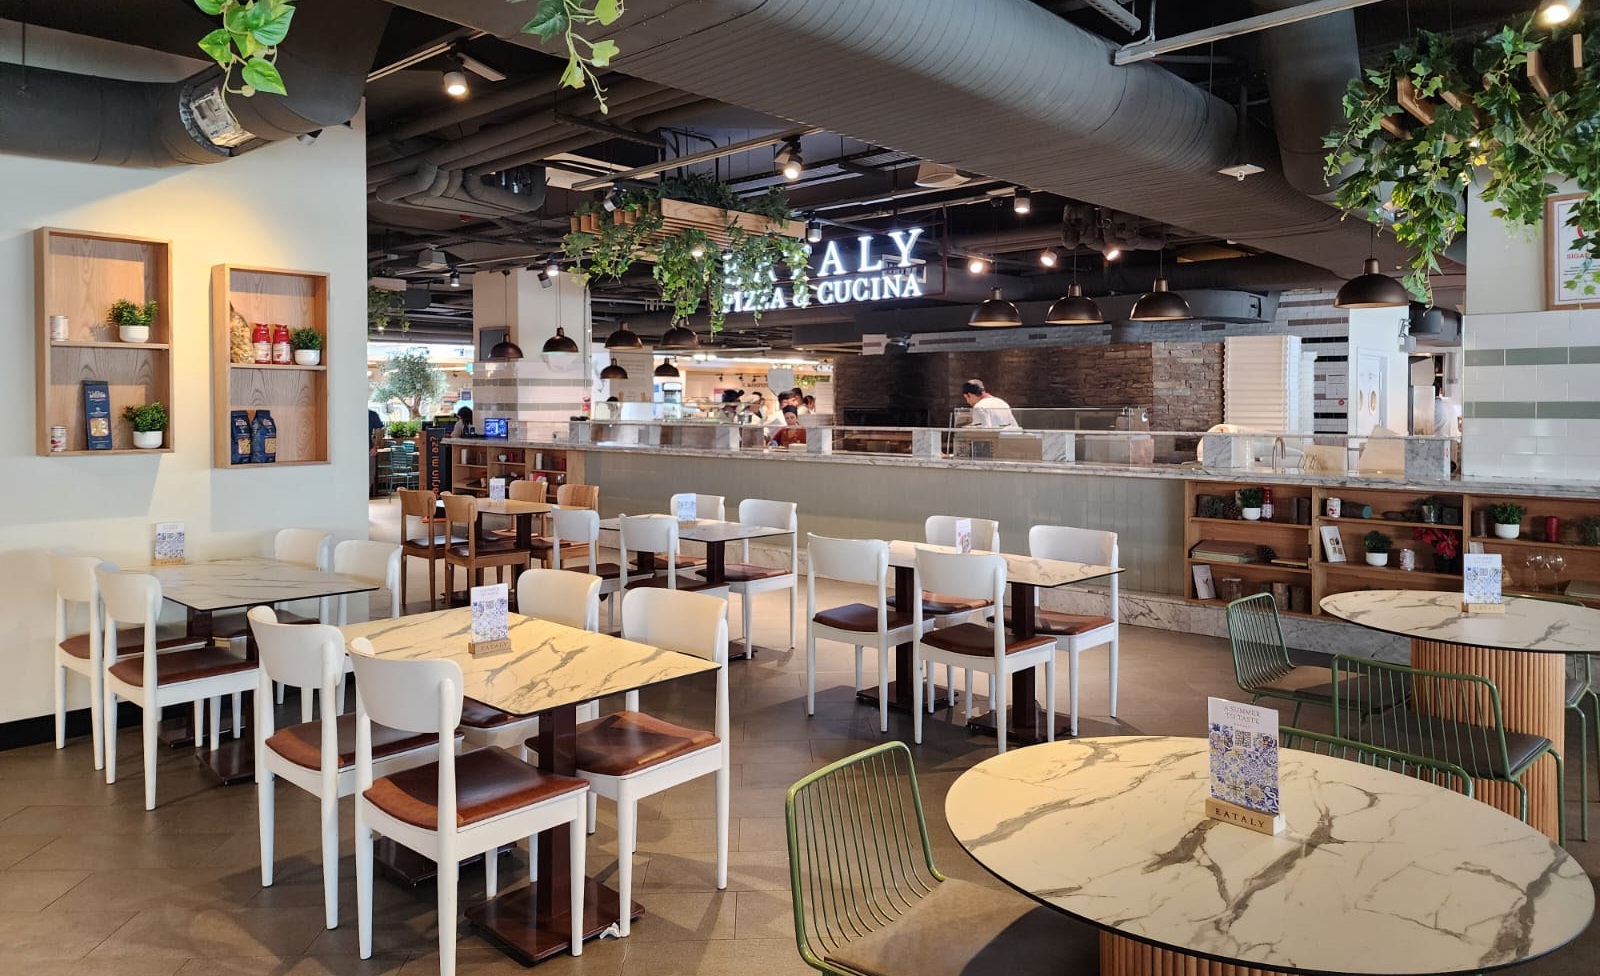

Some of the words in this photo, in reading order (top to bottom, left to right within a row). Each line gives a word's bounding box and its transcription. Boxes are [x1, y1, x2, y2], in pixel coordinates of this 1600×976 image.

[792, 285, 812, 308] &
[817, 273, 923, 305] CUCINA
[1229, 706, 1261, 717] SUMMER
[1237, 715, 1260, 724] TASTE
[1215, 807, 1265, 828] EATALY
